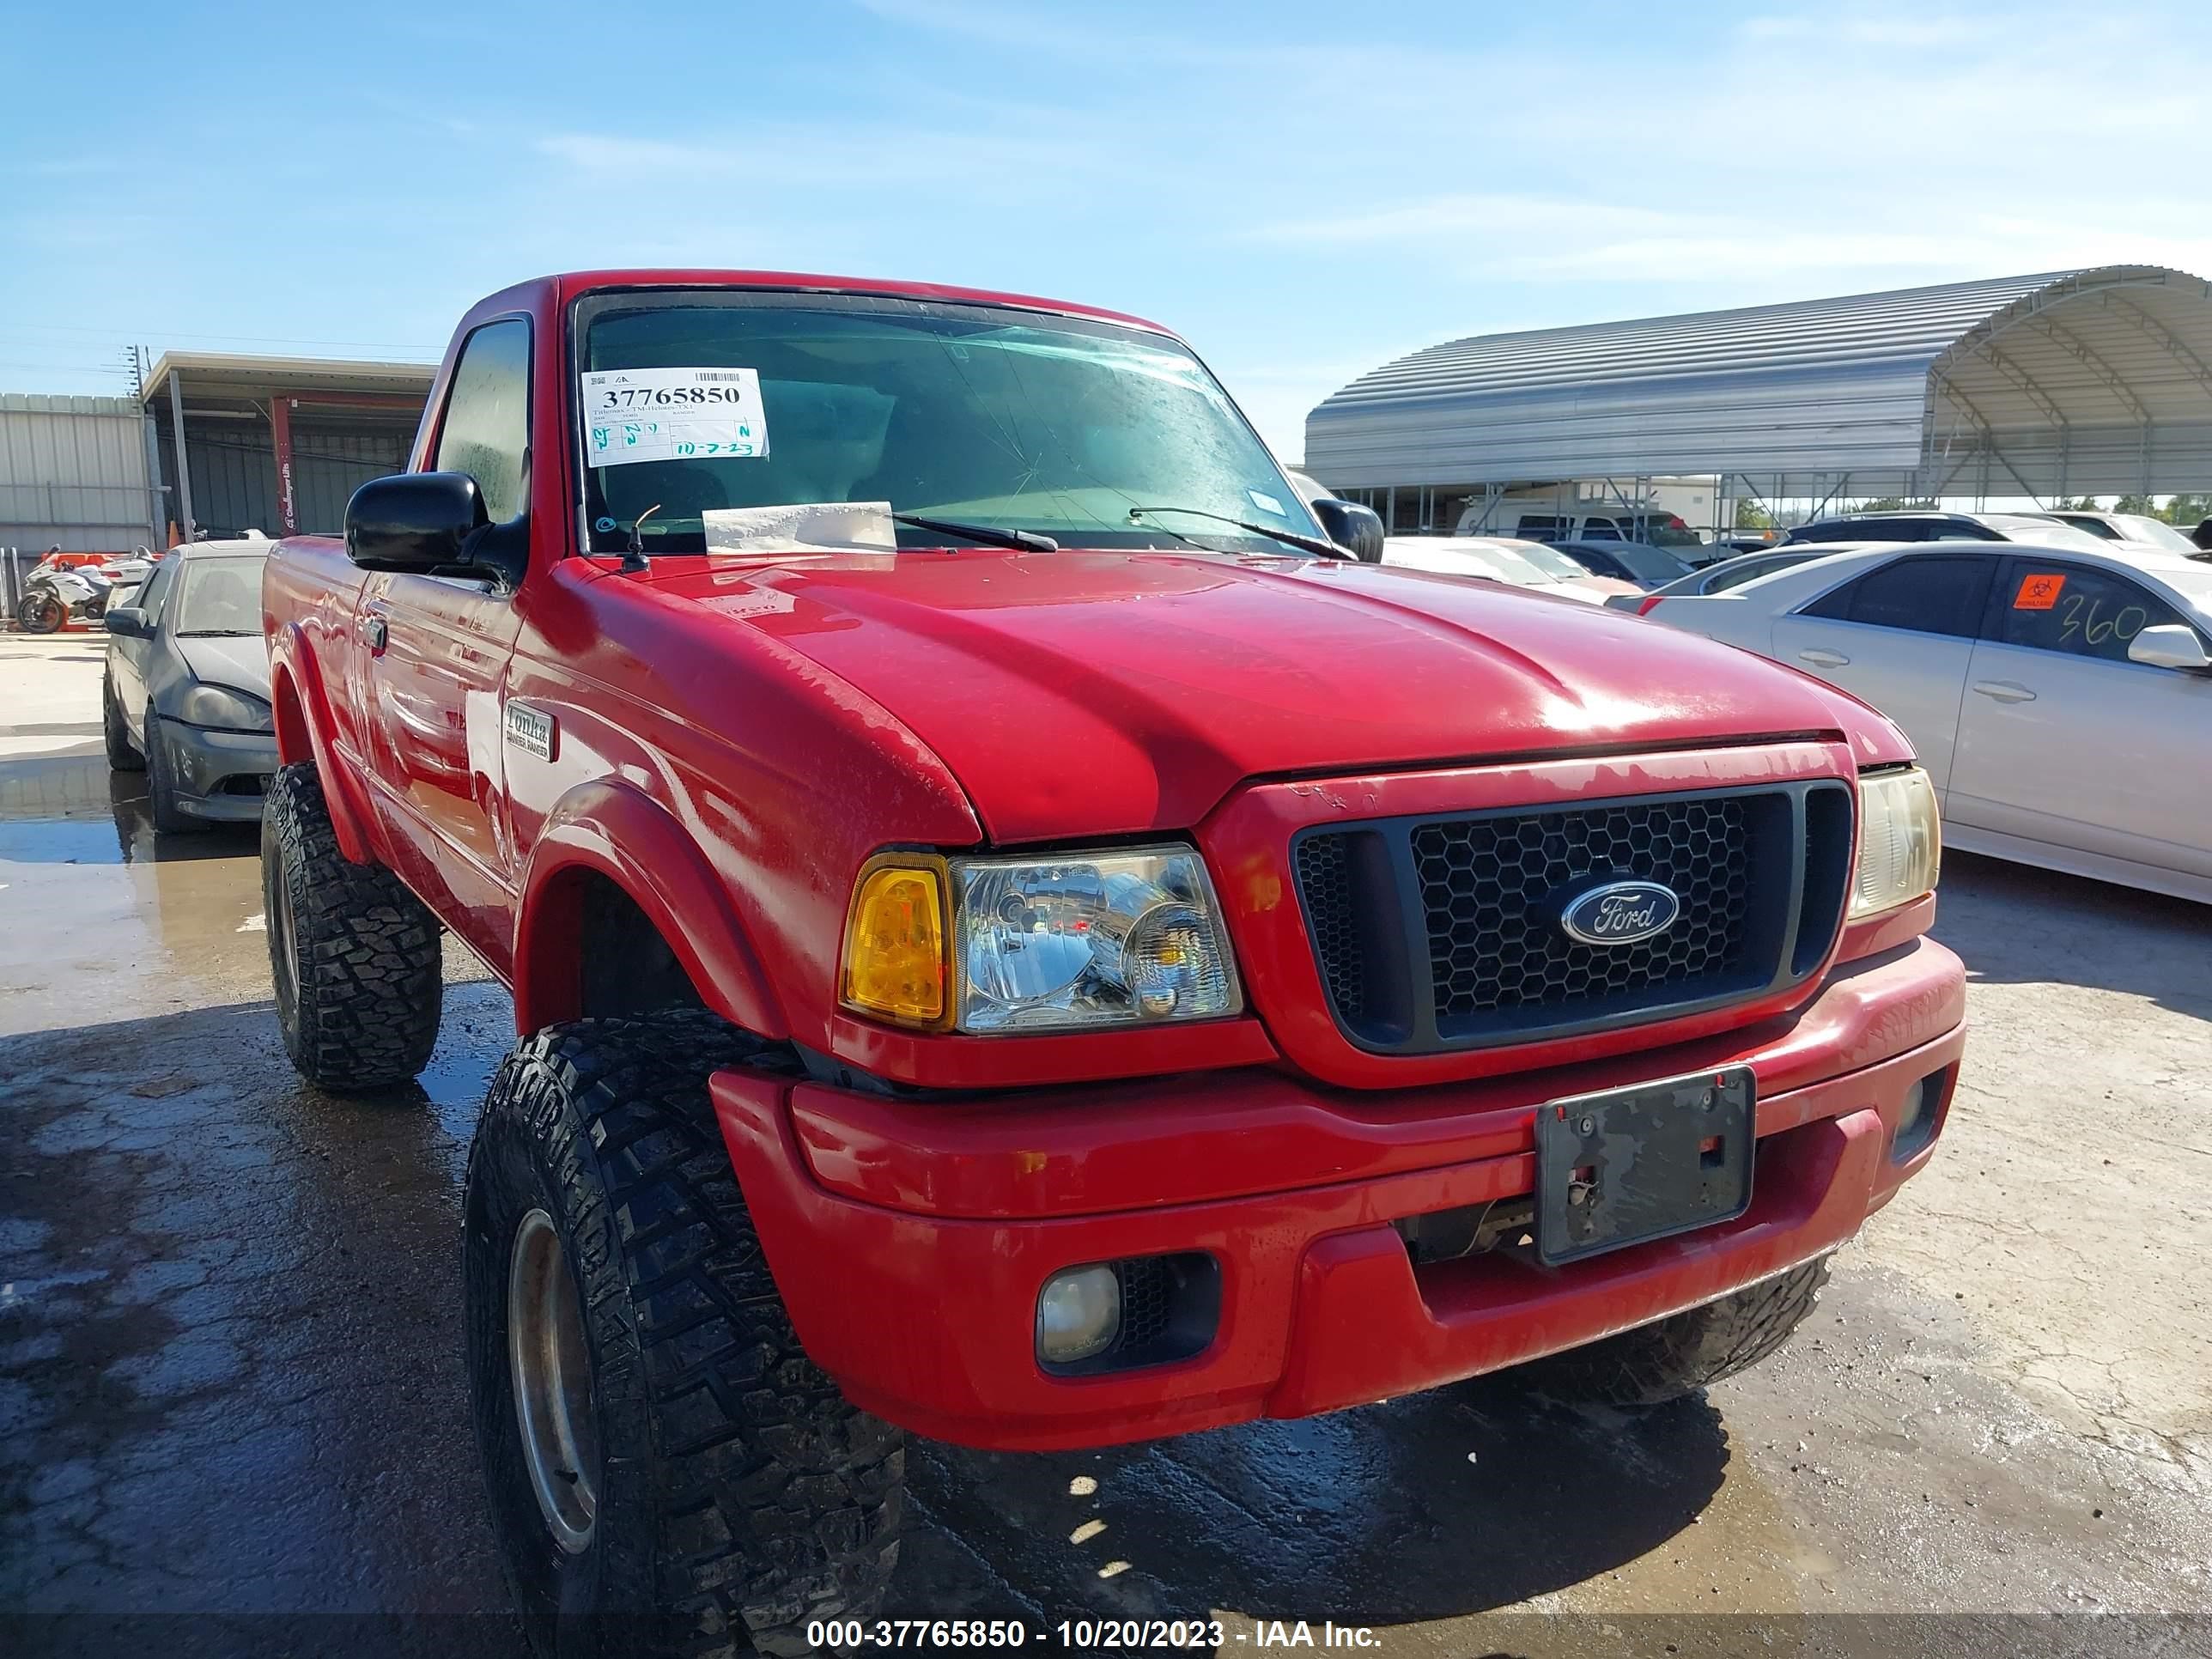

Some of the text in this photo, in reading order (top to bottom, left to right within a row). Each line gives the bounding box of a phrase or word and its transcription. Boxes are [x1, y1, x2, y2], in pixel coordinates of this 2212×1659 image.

[602, 386, 740, 409] 37765850
[2059, 594, 2147, 644] 360
[507, 704, 548, 744] Tonka
[1594, 895, 1656, 933] Ford
